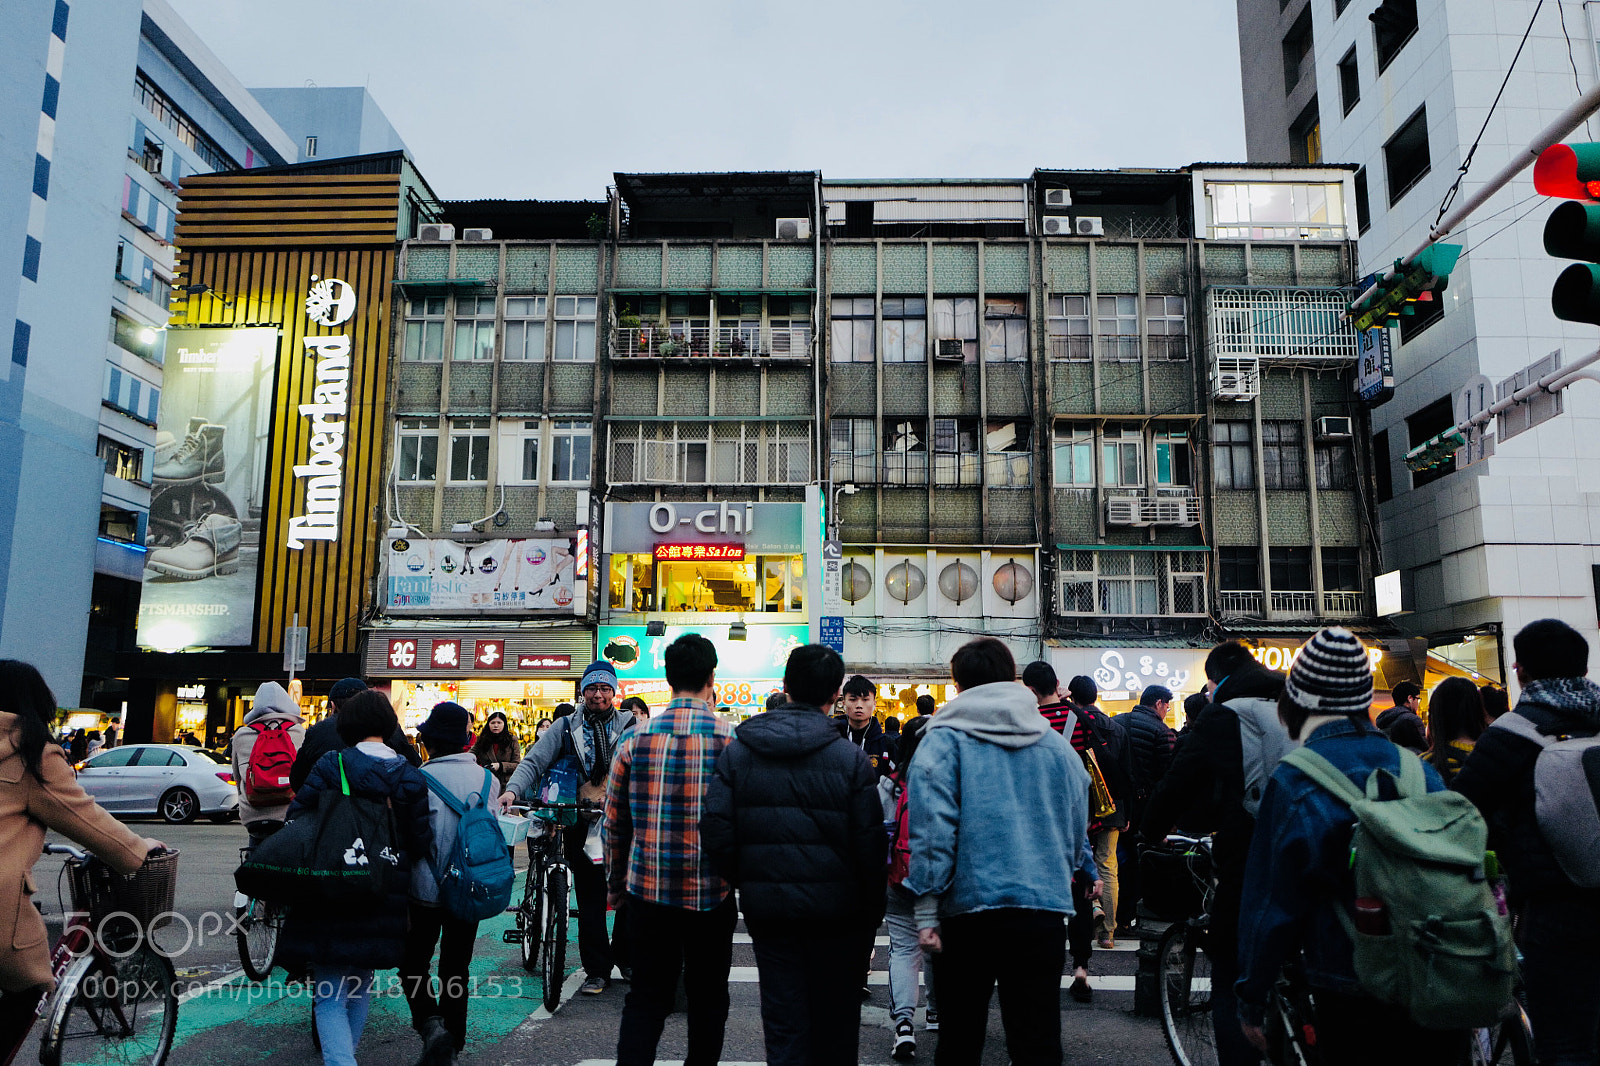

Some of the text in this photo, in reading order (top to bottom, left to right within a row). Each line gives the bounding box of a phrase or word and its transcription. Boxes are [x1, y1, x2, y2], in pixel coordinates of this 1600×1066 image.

[287, 333, 350, 550] Timberland
[649, 500, 754, 535] O-chi
[393, 575, 468, 594] Fantastic
[297, 866, 310, 875] BIG
